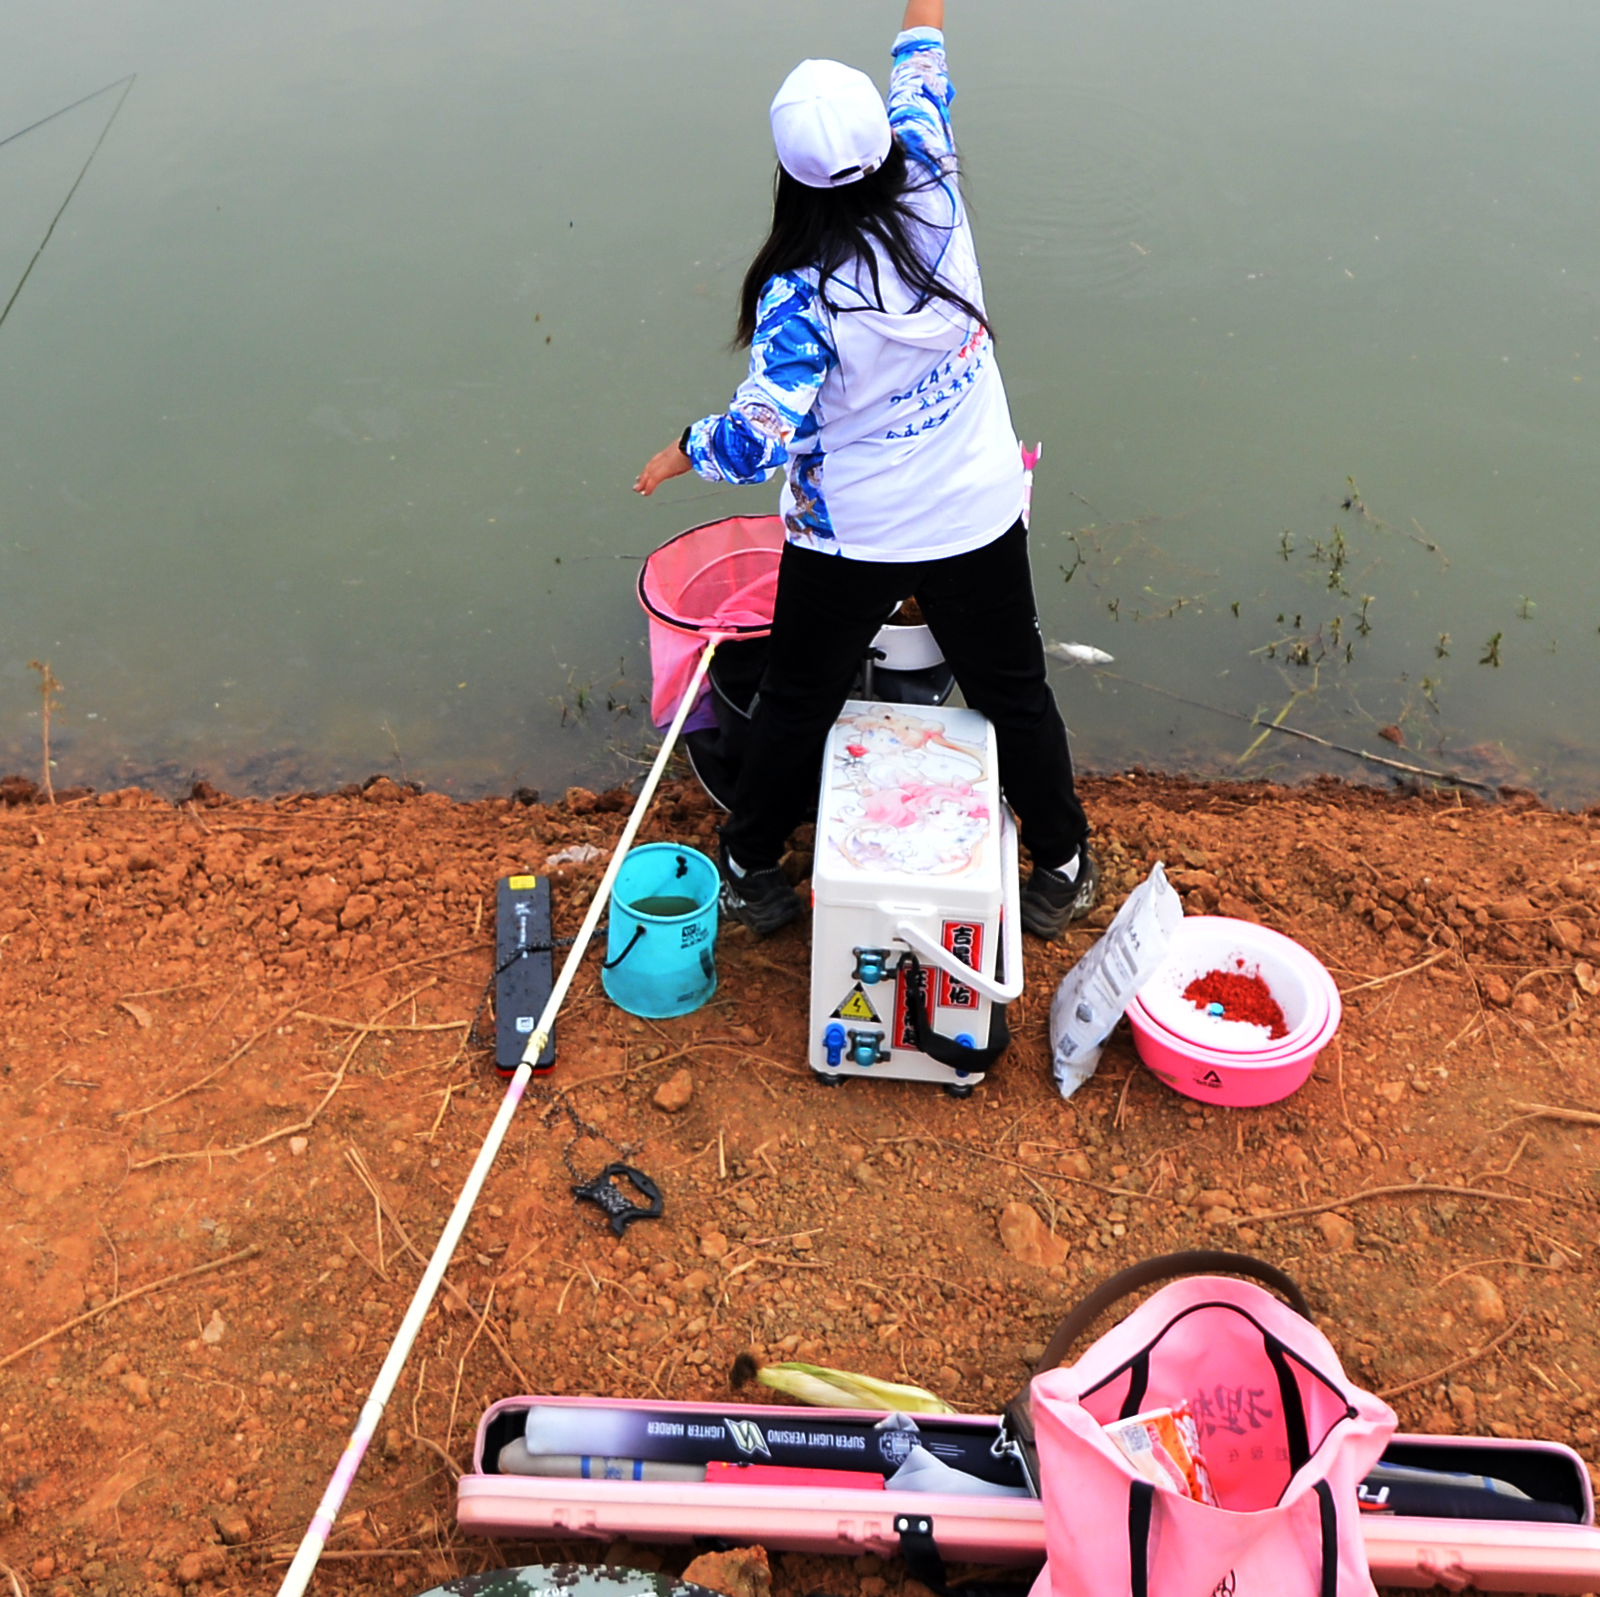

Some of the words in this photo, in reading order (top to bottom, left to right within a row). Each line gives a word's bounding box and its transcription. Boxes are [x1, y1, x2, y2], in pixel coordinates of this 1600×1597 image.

[647, 1421, 685, 1437] HARDER
[687, 1423, 725, 1439] LIGHTER
[808, 1432, 834, 1447] LIGHT
[836, 1434, 865, 1450] SUPER
